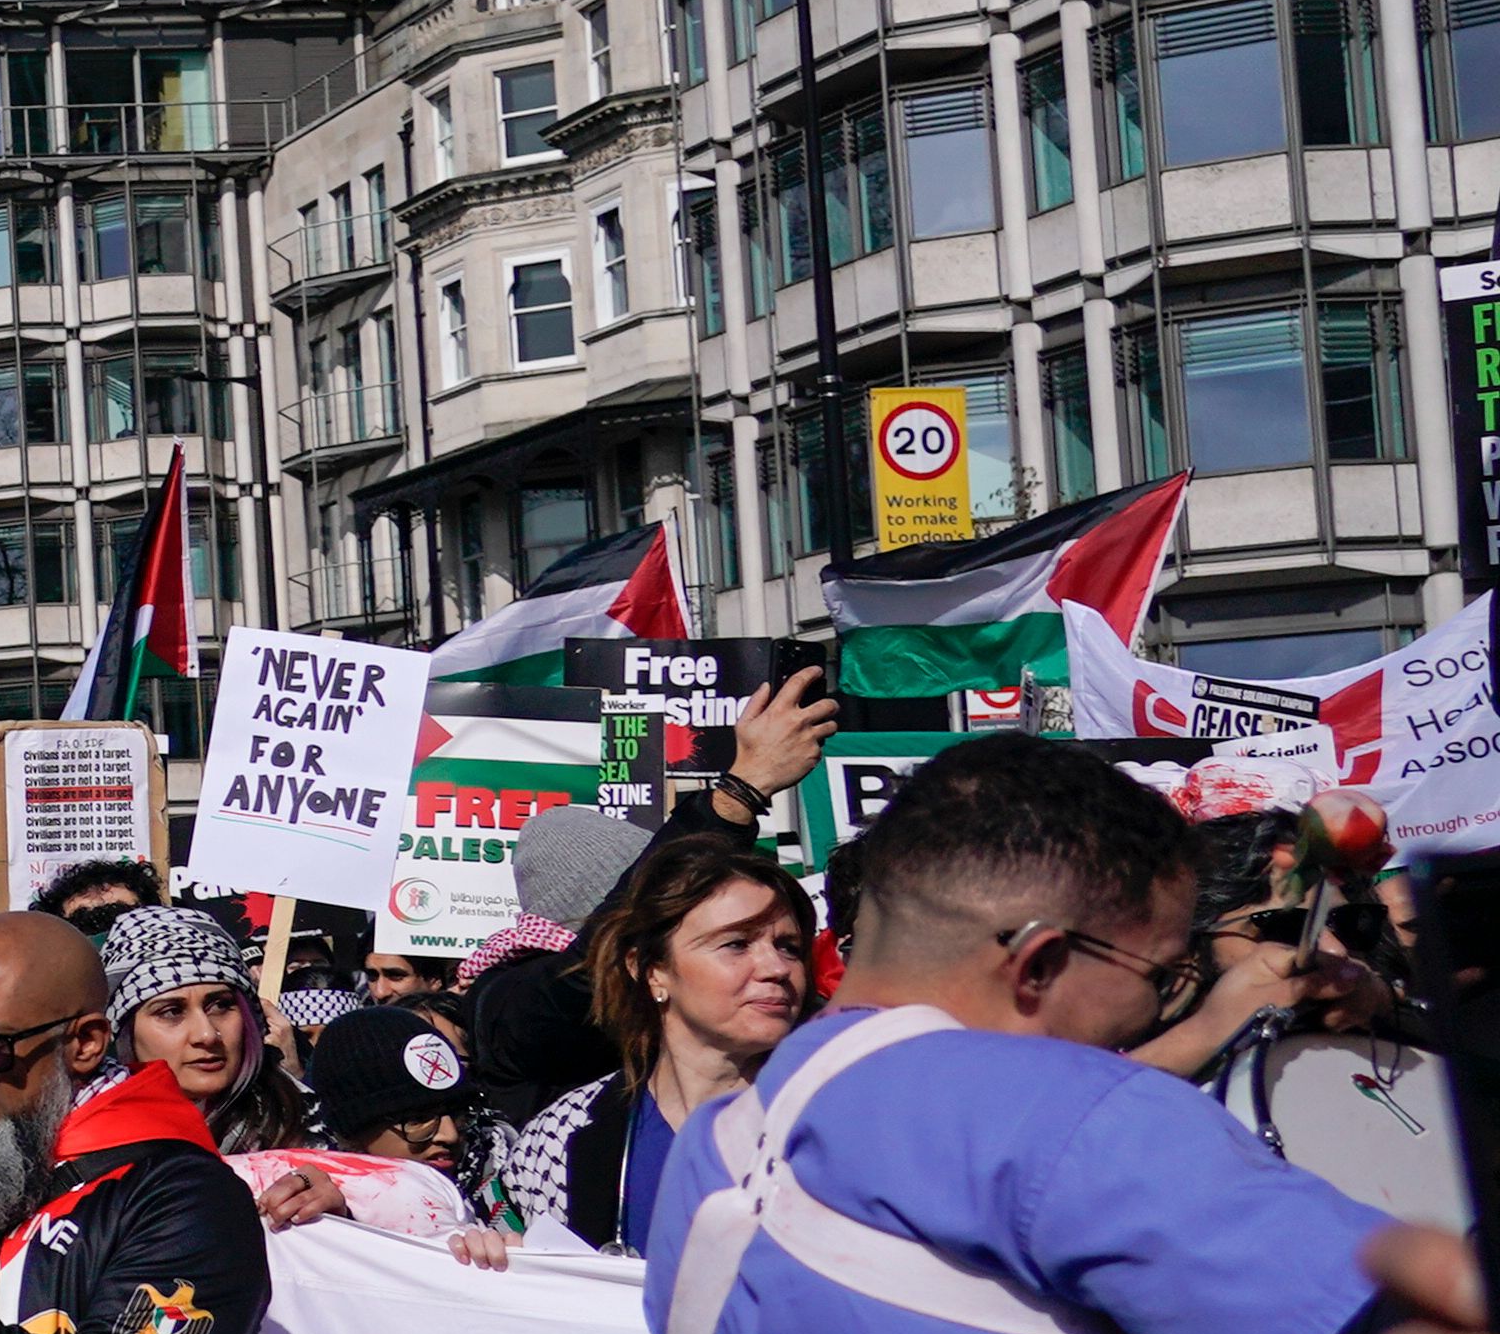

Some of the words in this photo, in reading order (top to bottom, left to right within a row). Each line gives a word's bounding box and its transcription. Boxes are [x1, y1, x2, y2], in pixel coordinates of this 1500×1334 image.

[893, 426, 946, 455] 20
[885, 494, 959, 511] Working
[887, 514, 906, 526] to
[912, 512, 958, 525] make
[888, 530, 965, 545] London's
[624, 647, 718, 687] Free
[251, 646, 386, 708] 'NEVER
[607, 699, 647, 711] Worker
[613, 715, 649, 738] THE
[24, 750, 60, 761] Civilians
[62, 751, 76, 760] are
[78, 749, 92, 759] not
[94, 750, 100, 759] a
[250, 735, 326, 776] FOR
[614, 739, 639, 760] TO
[24, 763, 60, 774] Civilians
[62, 764, 76, 773] are
[78, 763, 92, 773] not
[95, 763, 100, 772] a
[599, 761, 631, 783] SEA
[25, 776, 60, 787] Civilians
[63, 777, 76, 786] are
[78, 776, 93, 786] not
[95, 776, 101, 785] a
[26, 803, 61, 813] Civilians
[64, 803, 77, 813] are
[79, 802, 94, 812] not
[96, 803, 102, 812] a
[222, 774, 387, 829] ANYONE
[26, 816, 62, 827] Civilians
[64, 817, 78, 826] are
[80, 815, 94, 825] not
[97, 816, 102, 825] a
[1396, 813, 1469, 840] through
[27, 829, 62, 840] Civilians
[65, 830, 78, 839] are
[80, 829, 95, 839] not
[97, 829, 102, 838] a
[27, 842, 63, 853] Civilians
[65, 843, 79, 852] are
[81, 842, 95, 852] not
[97, 842, 103, 851] a
[450, 905, 505, 918] Palestinian
